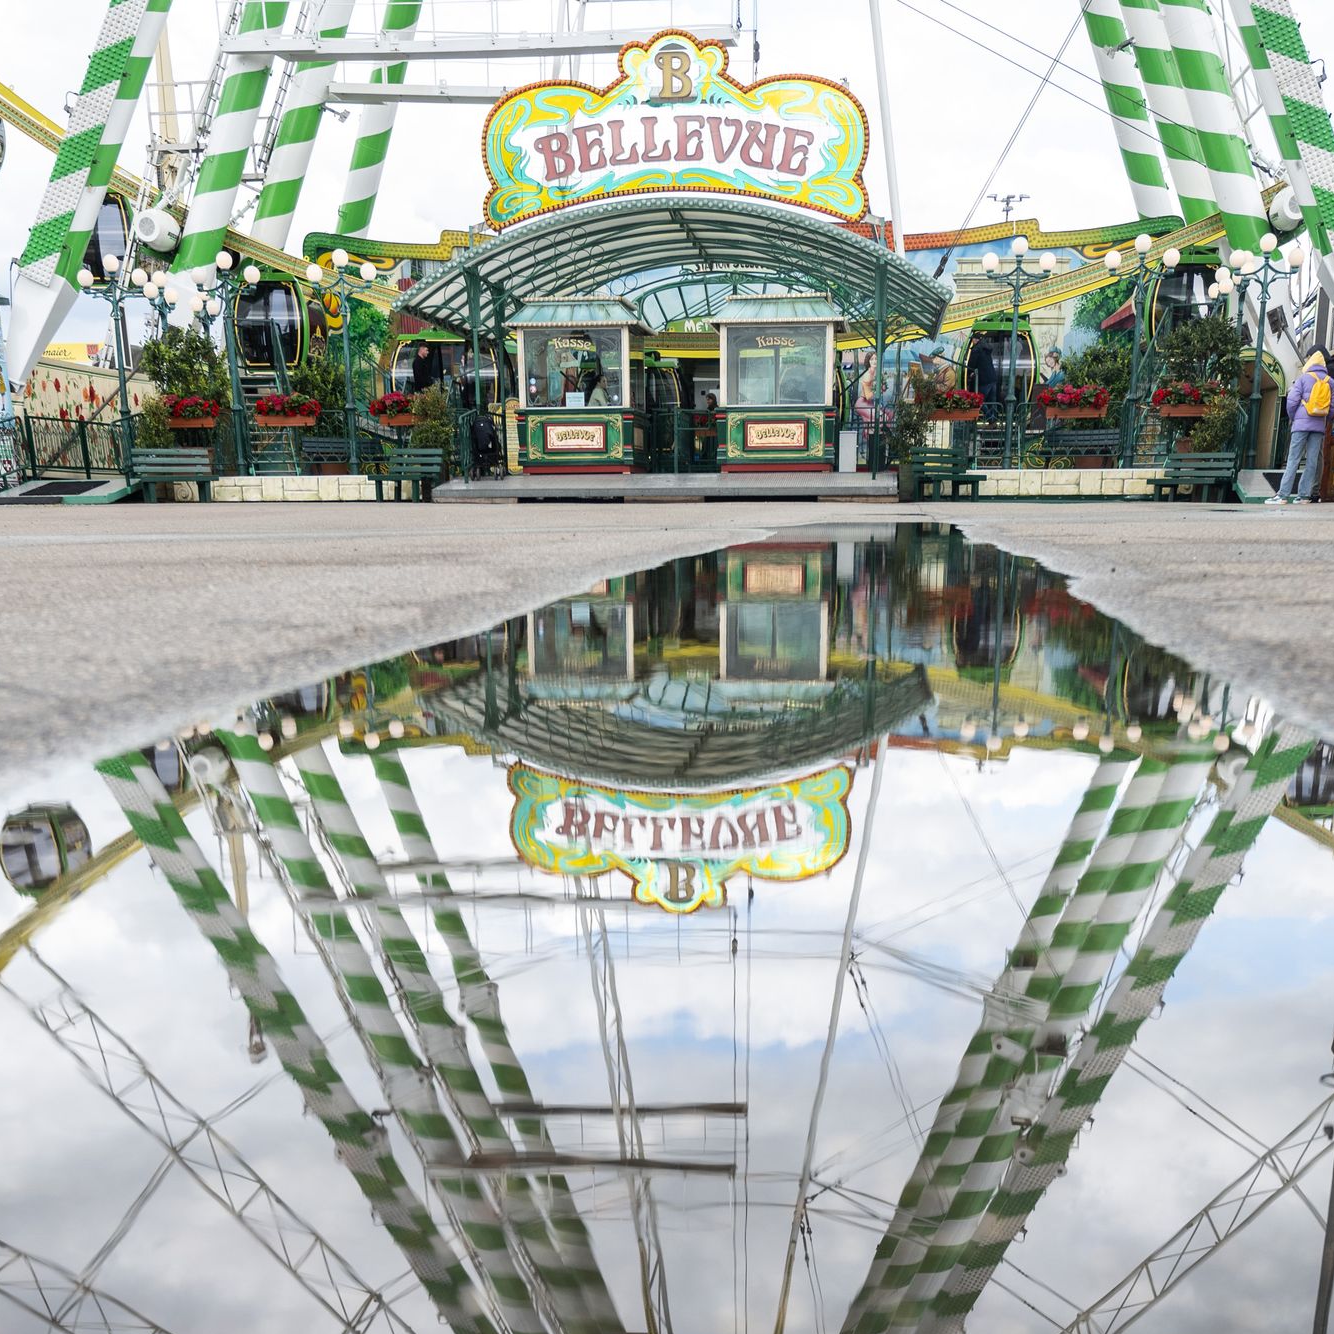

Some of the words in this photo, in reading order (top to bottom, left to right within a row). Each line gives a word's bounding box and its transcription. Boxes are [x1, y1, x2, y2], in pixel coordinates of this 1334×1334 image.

[655, 51, 693, 99] B
[533, 114, 815, 182] BELLEVUE
[553, 337, 592, 350] Kasse
[756, 336, 796, 347] Kasse
[43, 347, 71, 357] maier
